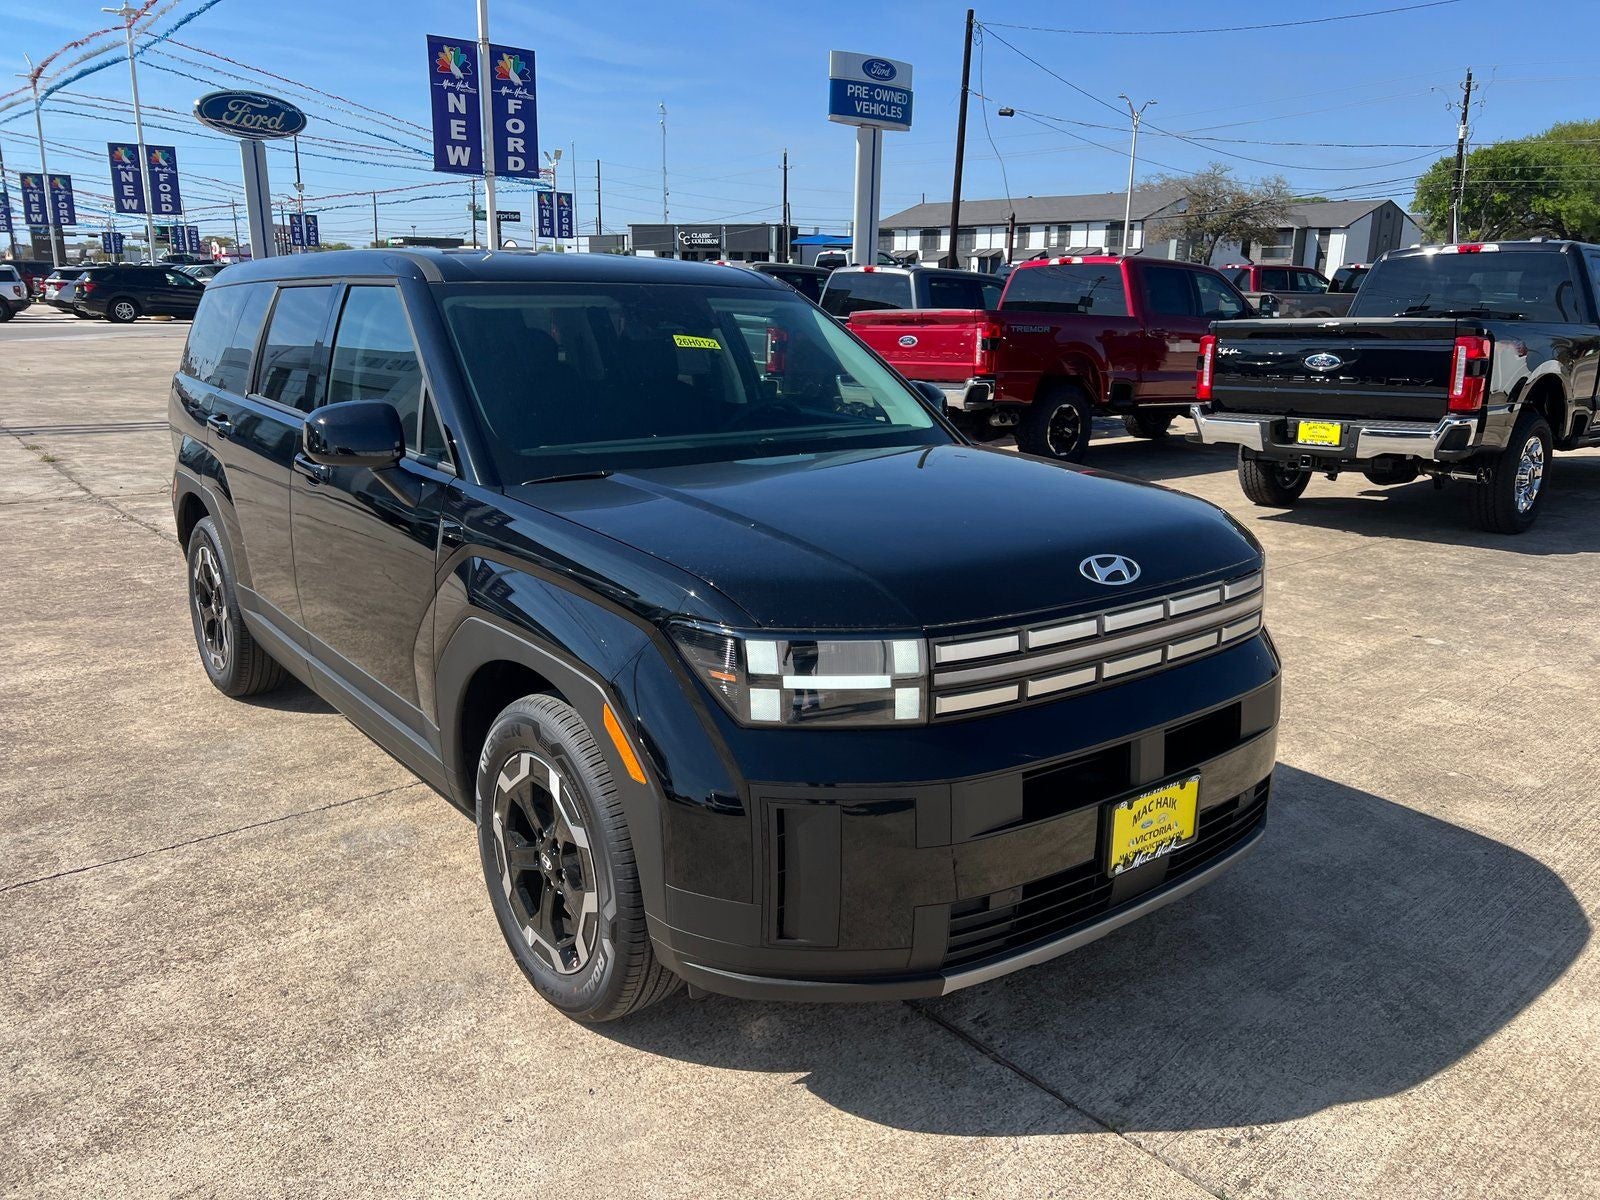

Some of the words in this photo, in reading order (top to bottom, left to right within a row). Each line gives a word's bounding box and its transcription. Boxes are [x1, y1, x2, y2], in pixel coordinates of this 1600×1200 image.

[871, 62, 890, 77] Ford
[847, 84, 908, 105] PRE-OWNED
[222, 99, 285, 130] Ford
[855, 101, 903, 118] VEHICLES
[446, 92, 471, 167] NEW
[505, 99, 525, 171] FORD
[120, 171, 138, 210] NEW
[158, 173, 173, 212] FORD
[29, 193, 42, 222] NEW
[58, 194, 69, 224] FORD
[496, 212, 520, 220] rprise
[542, 209, 551, 235] NEW
[676, 337, 719, 348] 26H0122
[1010, 325, 1051, 333] TREMOR
[1132, 800, 1154, 827] MAC
[1156, 797, 1177, 810] HAIK
[1135, 824, 1172, 844] VICTORIA
